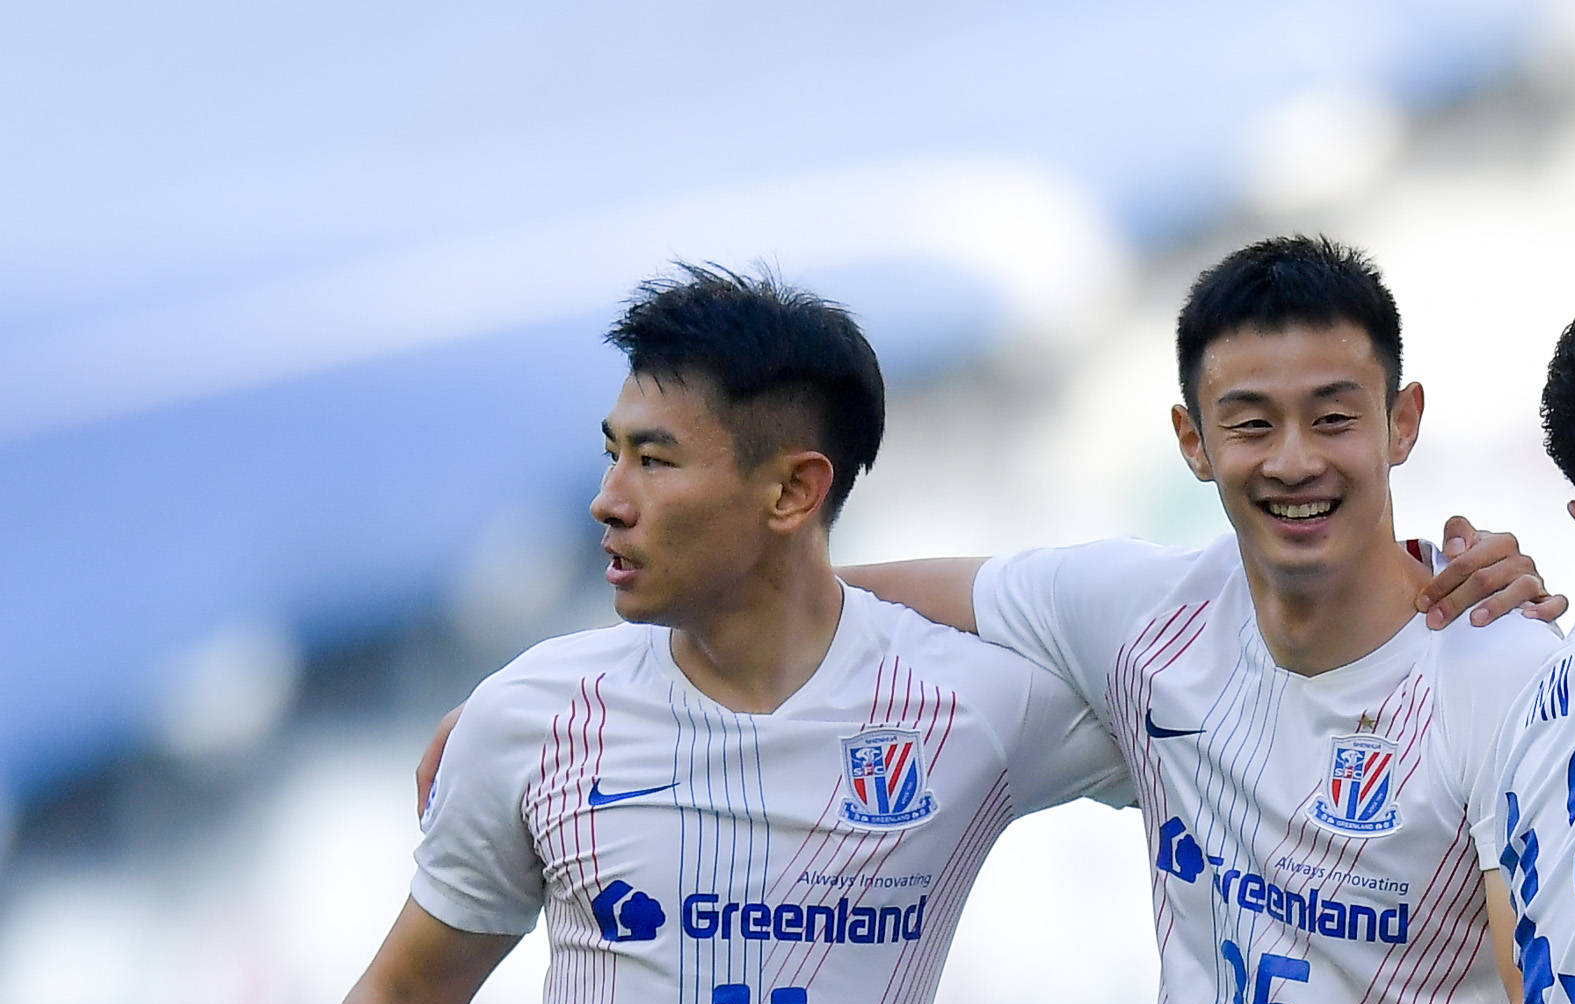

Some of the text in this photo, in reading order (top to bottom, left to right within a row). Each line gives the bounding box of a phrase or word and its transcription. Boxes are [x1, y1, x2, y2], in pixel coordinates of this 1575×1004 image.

[852, 765, 885, 777] SFC
[1333, 767, 1363, 779] SFC
[797, 870, 933, 890] Always Innovating
[1274, 856, 1410, 896] Always Innovating
[1205, 854, 1410, 945] Greenland
[682, 893, 928, 944] Greenland
